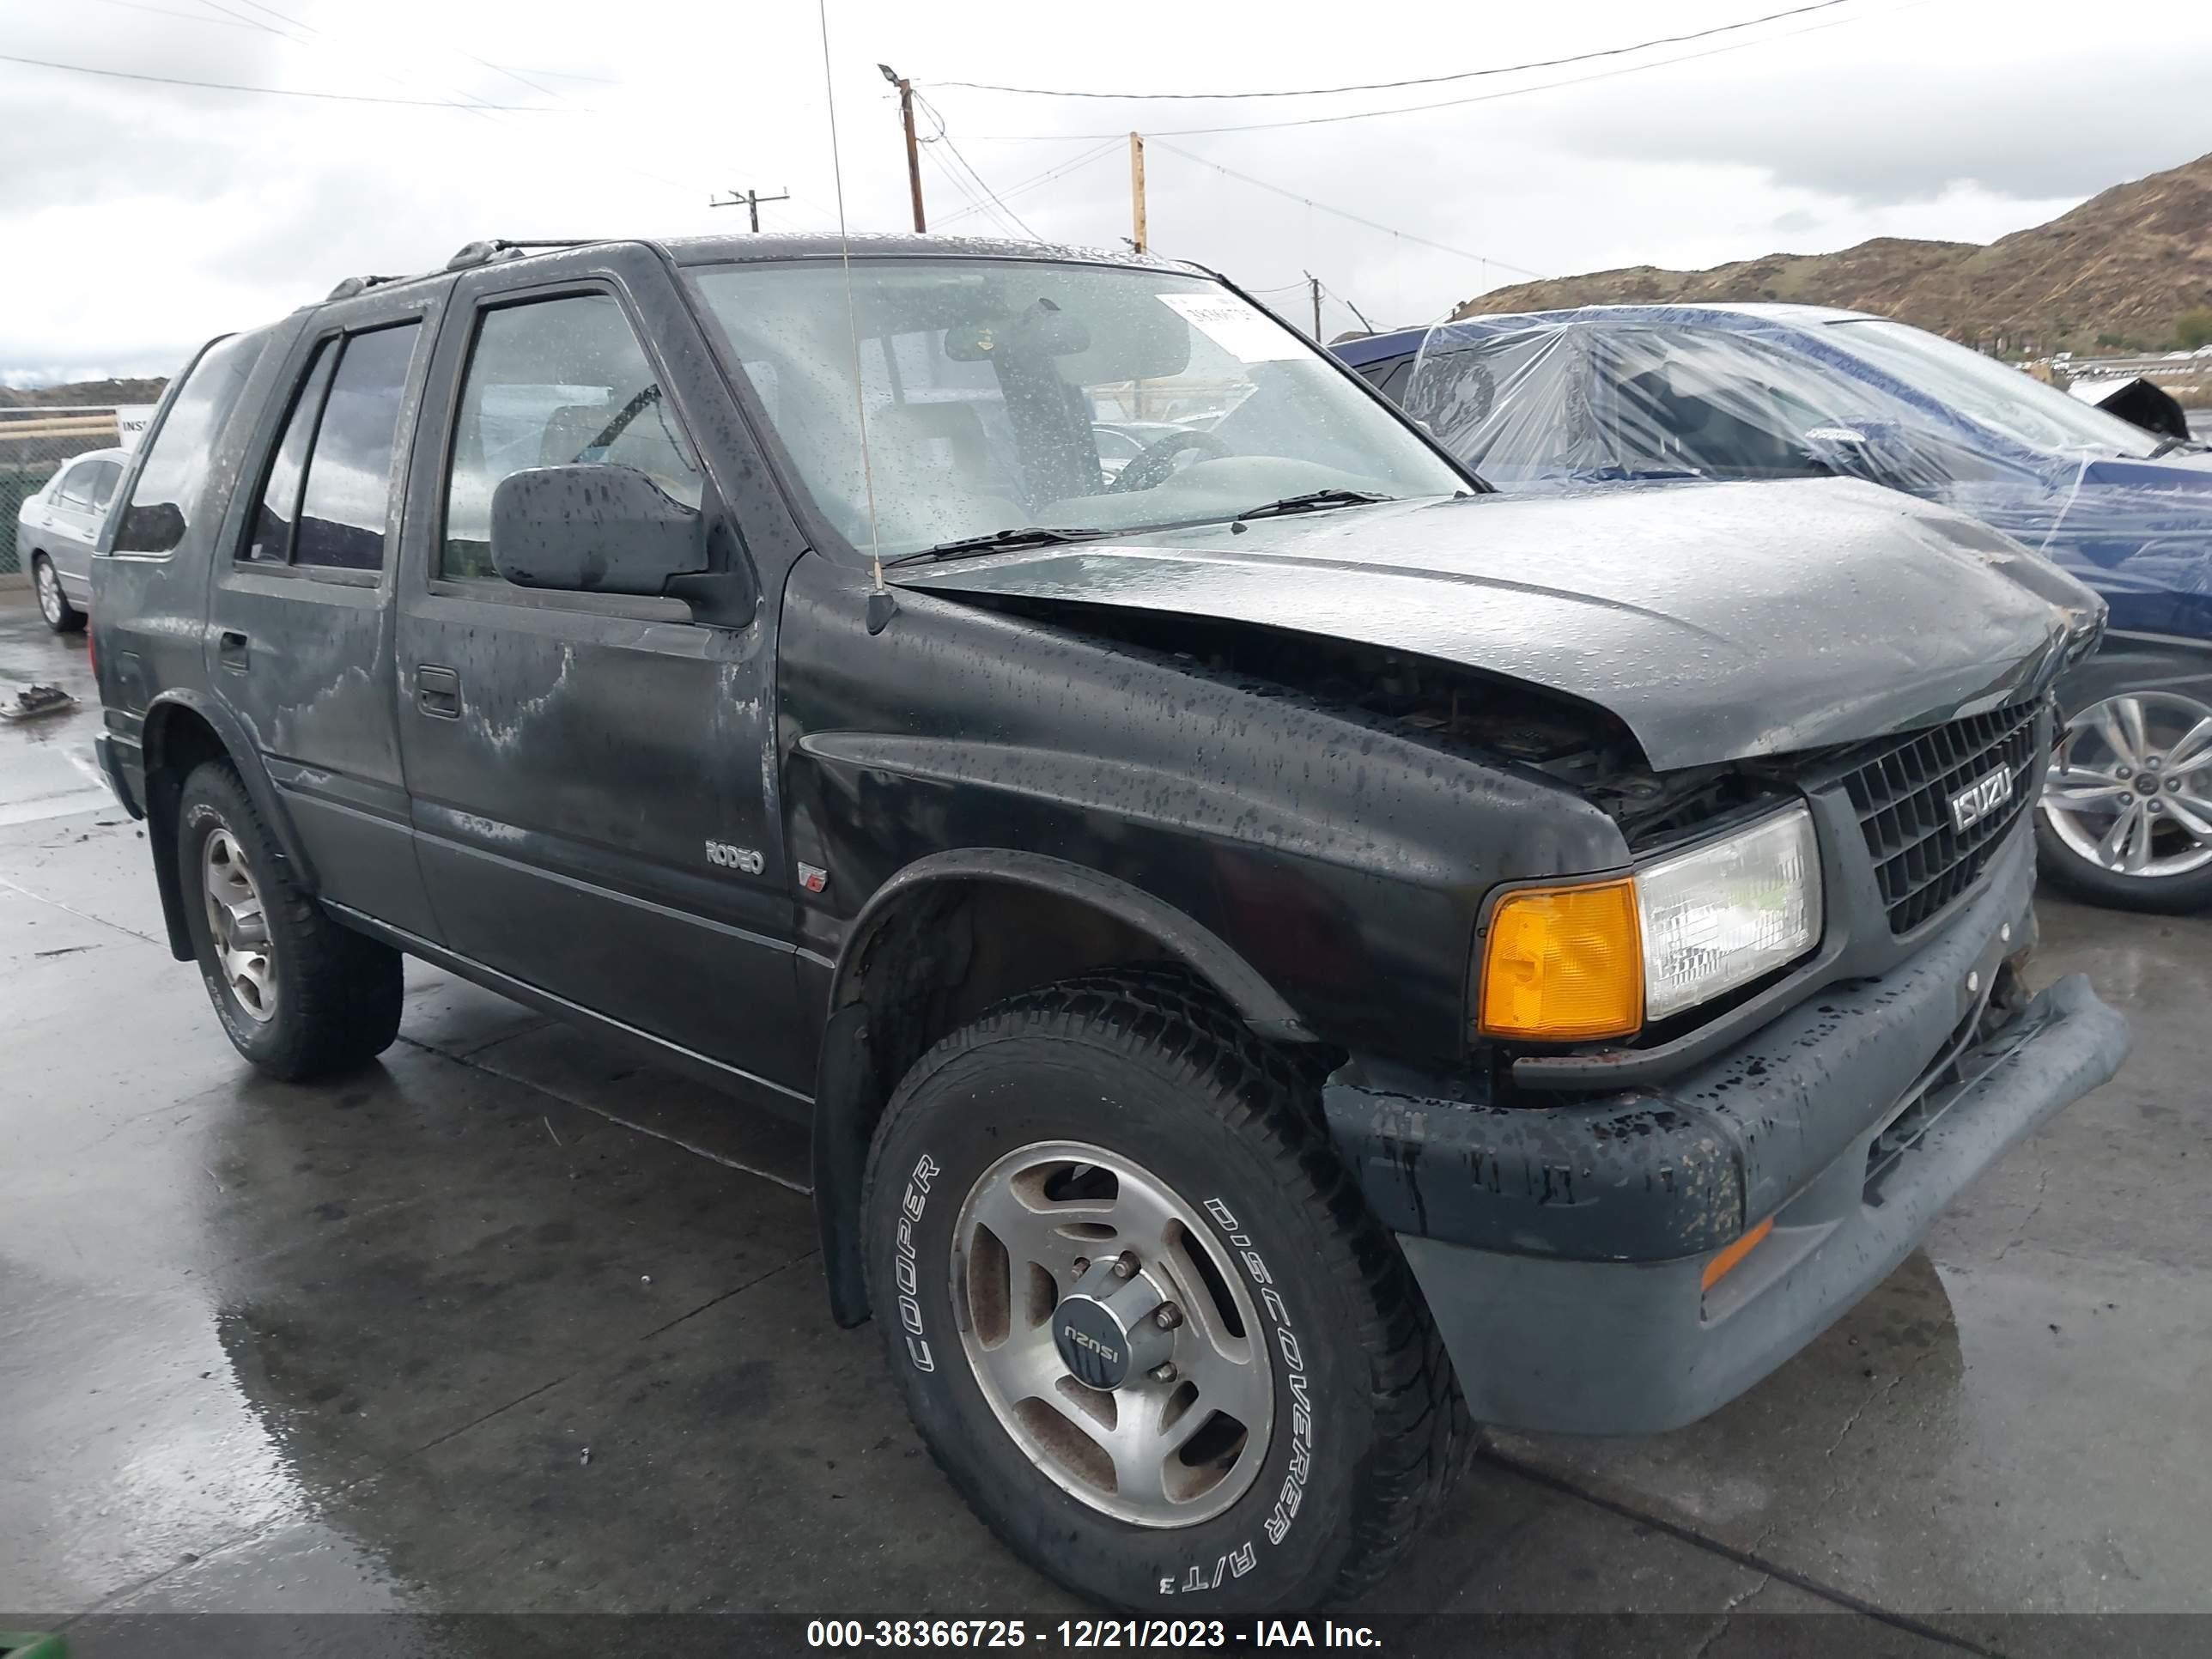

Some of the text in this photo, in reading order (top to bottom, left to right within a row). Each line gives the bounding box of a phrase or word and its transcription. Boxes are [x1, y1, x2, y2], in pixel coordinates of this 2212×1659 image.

[123, 420, 146, 431] INS
[1952, 766, 2013, 832] ISUZU
[704, 839, 765, 876] RODEO
[895, 1153, 941, 1374] COOPER
[1064, 1325, 1119, 1364] ISUZU
[1203, 1197, 1313, 1546] DISCOVERER
